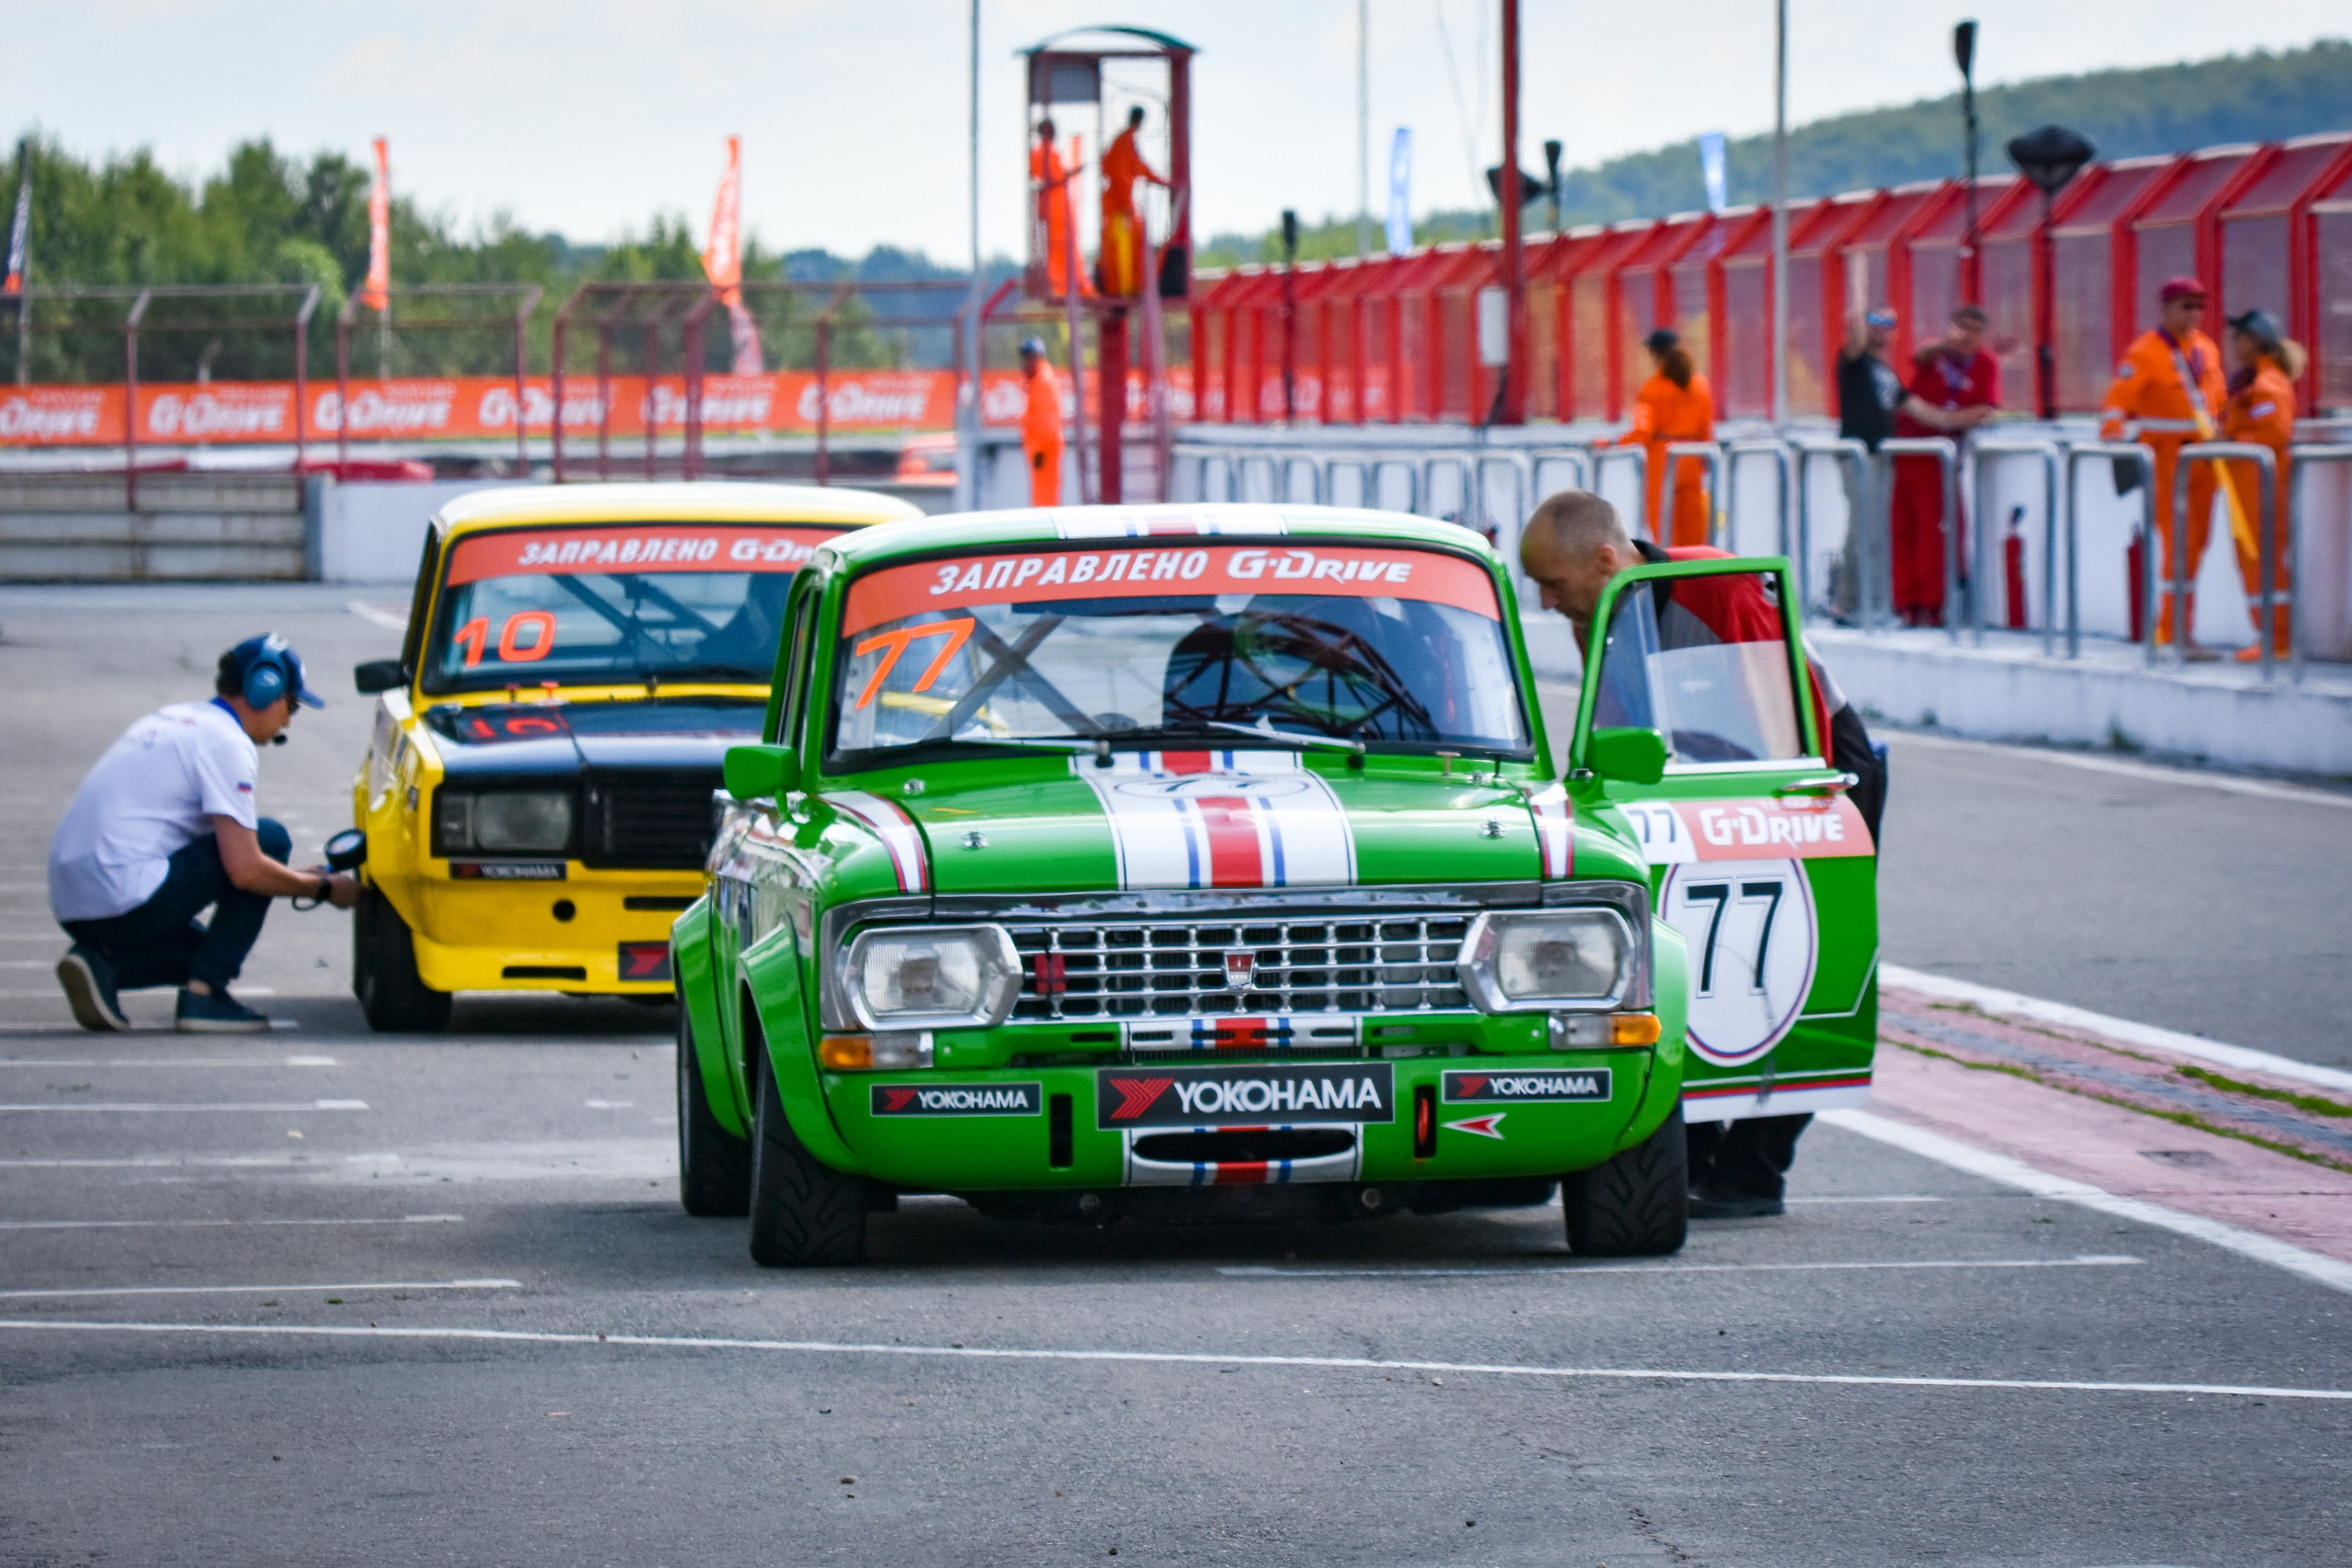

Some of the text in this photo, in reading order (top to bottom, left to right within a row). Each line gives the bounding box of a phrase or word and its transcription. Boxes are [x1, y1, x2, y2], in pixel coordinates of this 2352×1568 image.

[517, 537, 719, 566] ЗАПРАВЛЕНО
[929, 549, 1210, 595] ЗАПРАВЛЕНО
[454, 610, 557, 668] 10
[855, 616, 977, 711] 77
[1626, 808, 1678, 844] 77
[1683, 876, 1785, 998] 77
[917, 1089, 1030, 1110] YOKOHAMA
[1173, 1077, 1383, 1114] YOKOHAMA
[1488, 1076, 1600, 1096] YOKOHAMA
